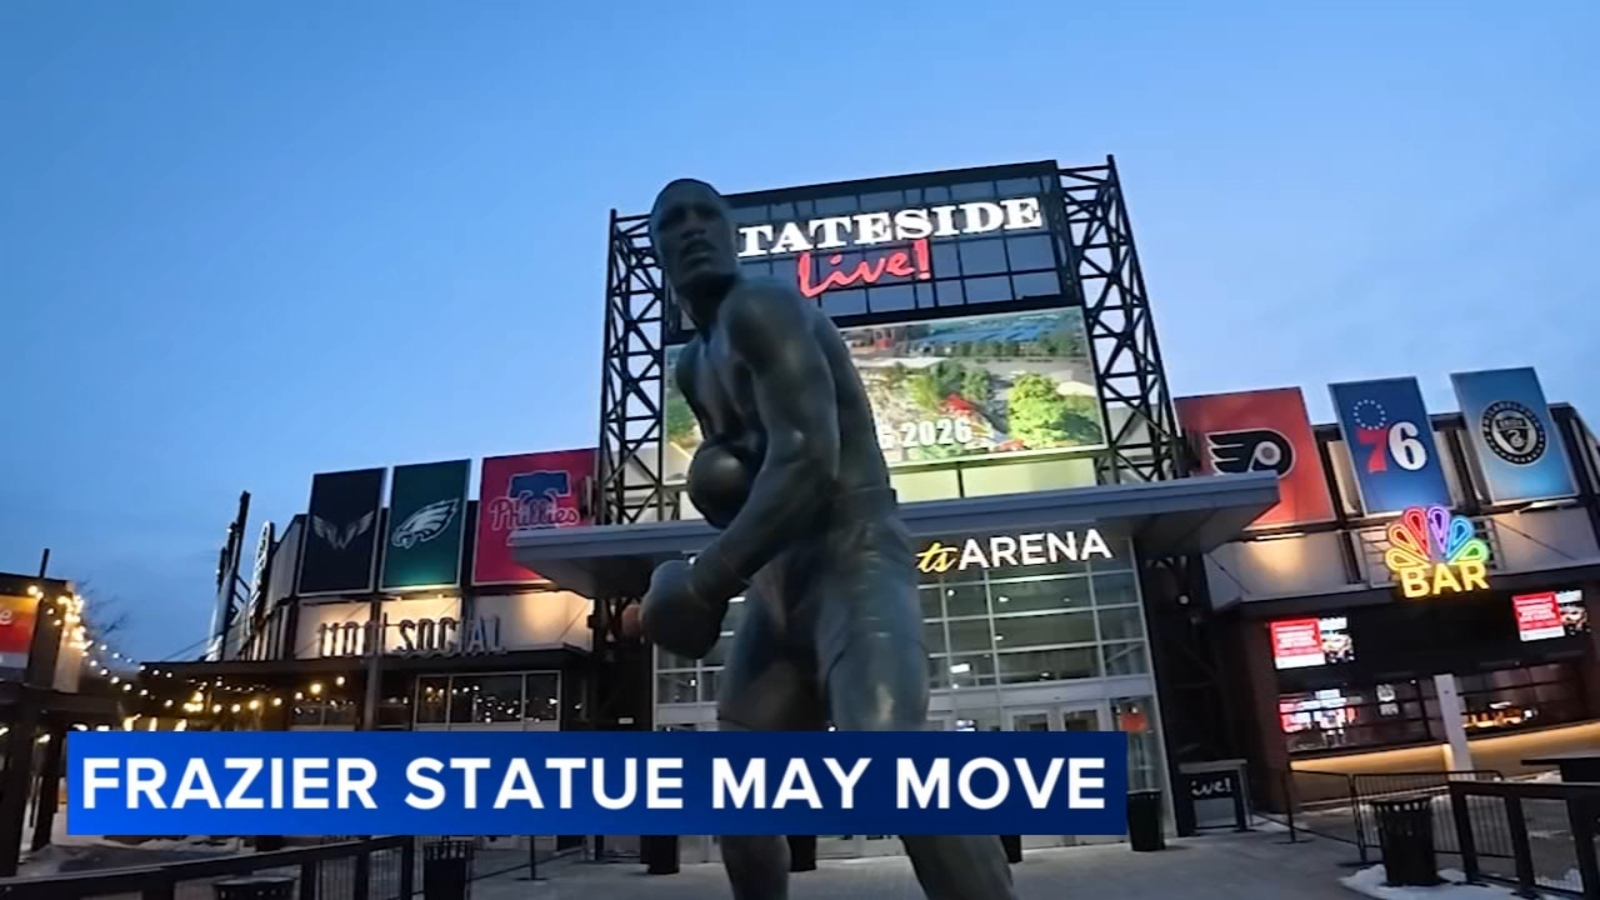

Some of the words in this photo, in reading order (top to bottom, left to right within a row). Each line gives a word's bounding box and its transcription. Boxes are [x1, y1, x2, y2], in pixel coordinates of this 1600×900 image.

[737, 197, 1043, 258] TATESIDE
[797, 238, 933, 298] Live!
[900, 417, 973, 449] 2026
[1356, 421, 1428, 474] 76
[489, 496, 581, 531] Phillies
[916, 542, 958, 573] ts
[958, 528, 1113, 571] ARENA
[1400, 560, 1490, 599] BAR
[396, 615, 508, 660] SOCIAL
